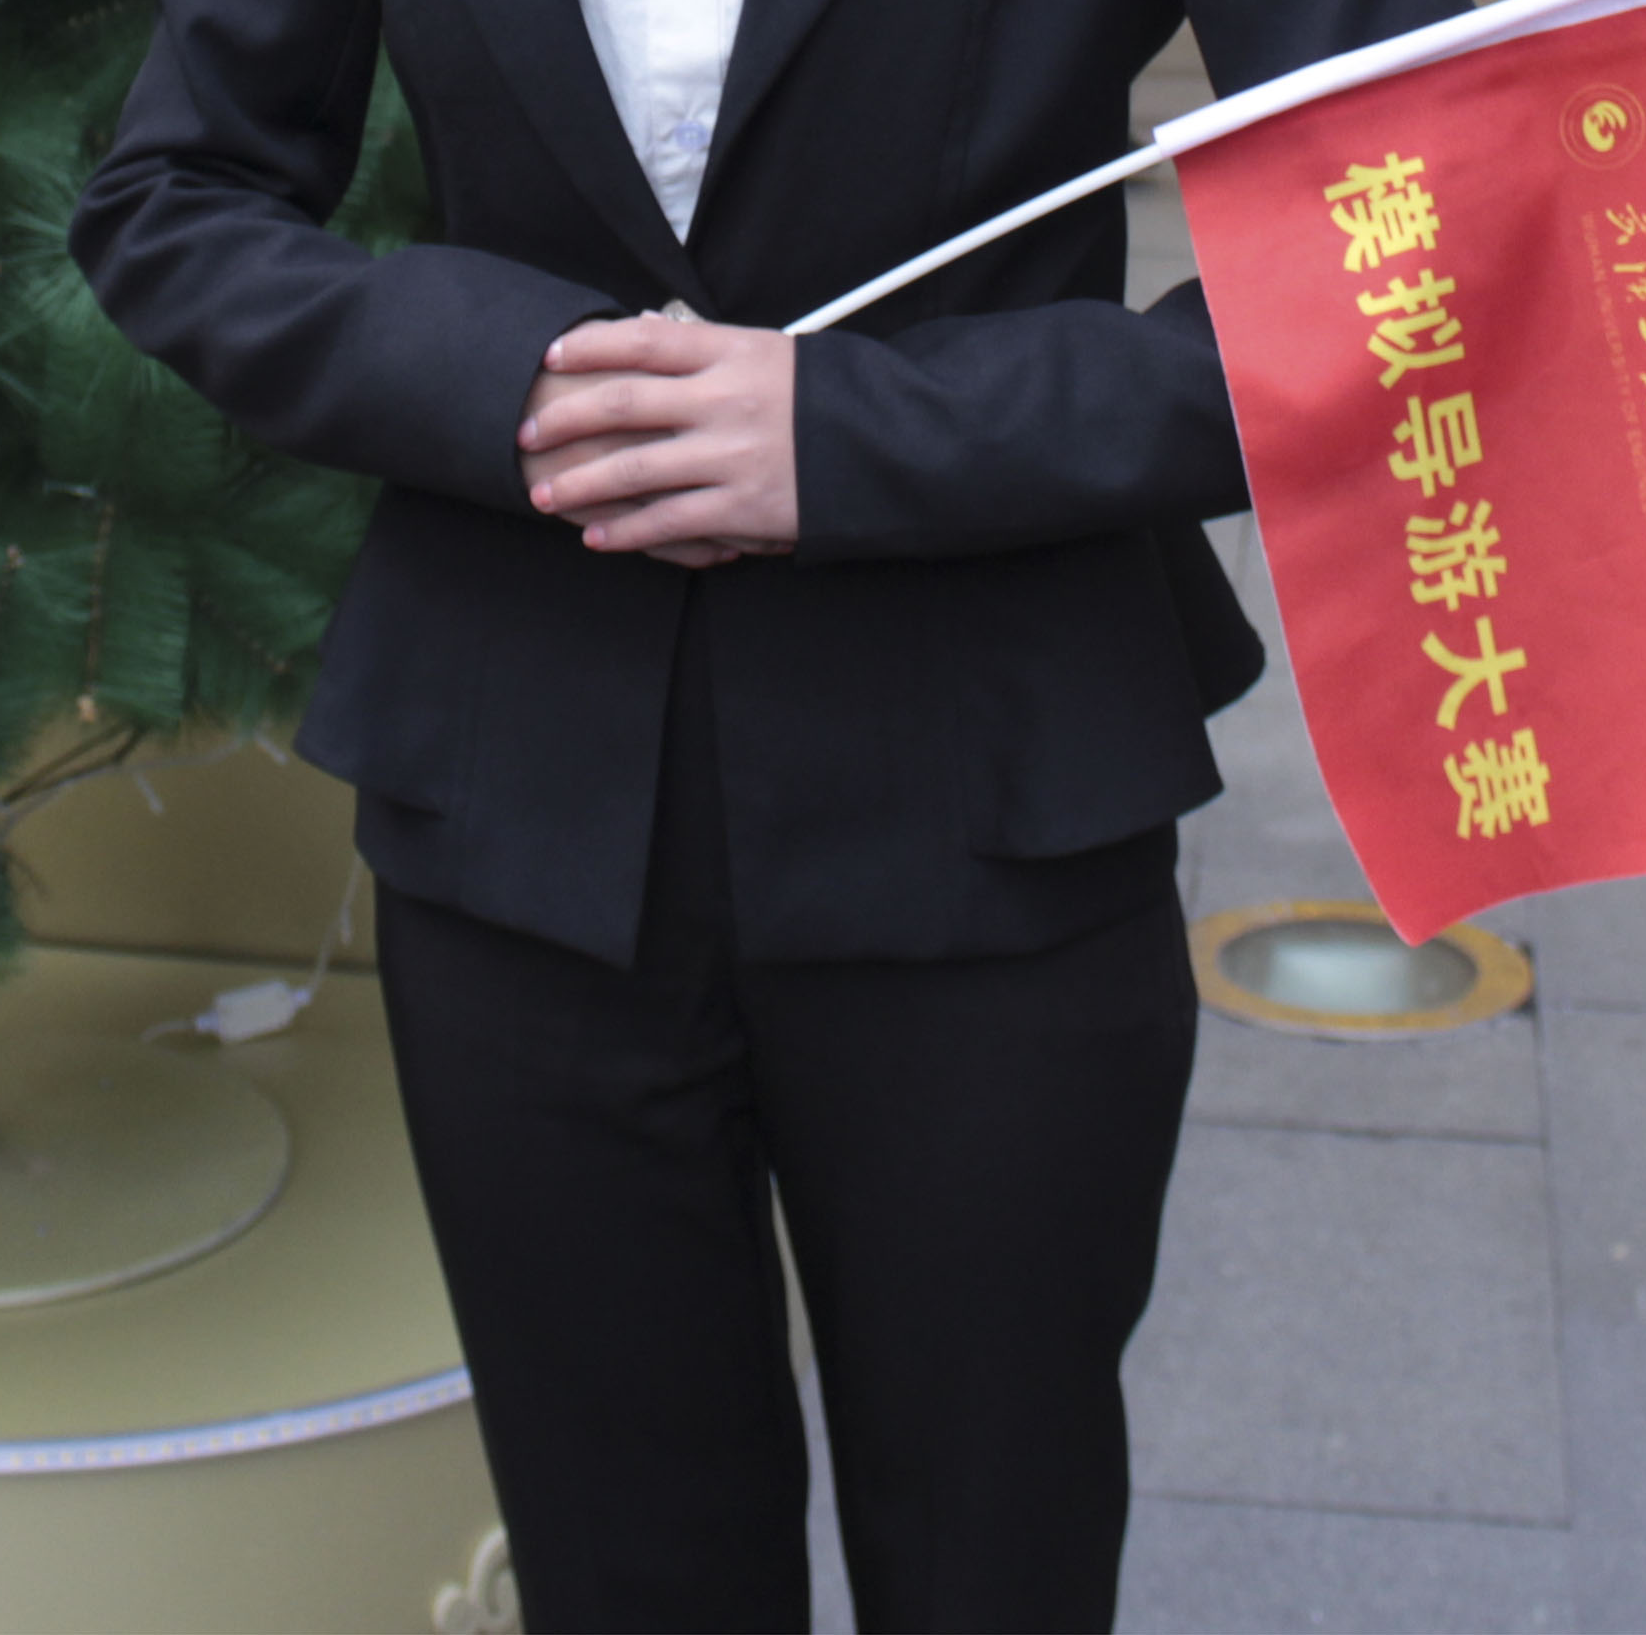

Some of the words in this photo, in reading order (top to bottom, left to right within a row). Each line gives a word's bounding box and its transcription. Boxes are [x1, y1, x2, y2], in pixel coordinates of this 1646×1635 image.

[1583, 213, 1606, 282] WUHAN
[1323, 152, 1551, 839] 模拟导游大赛
